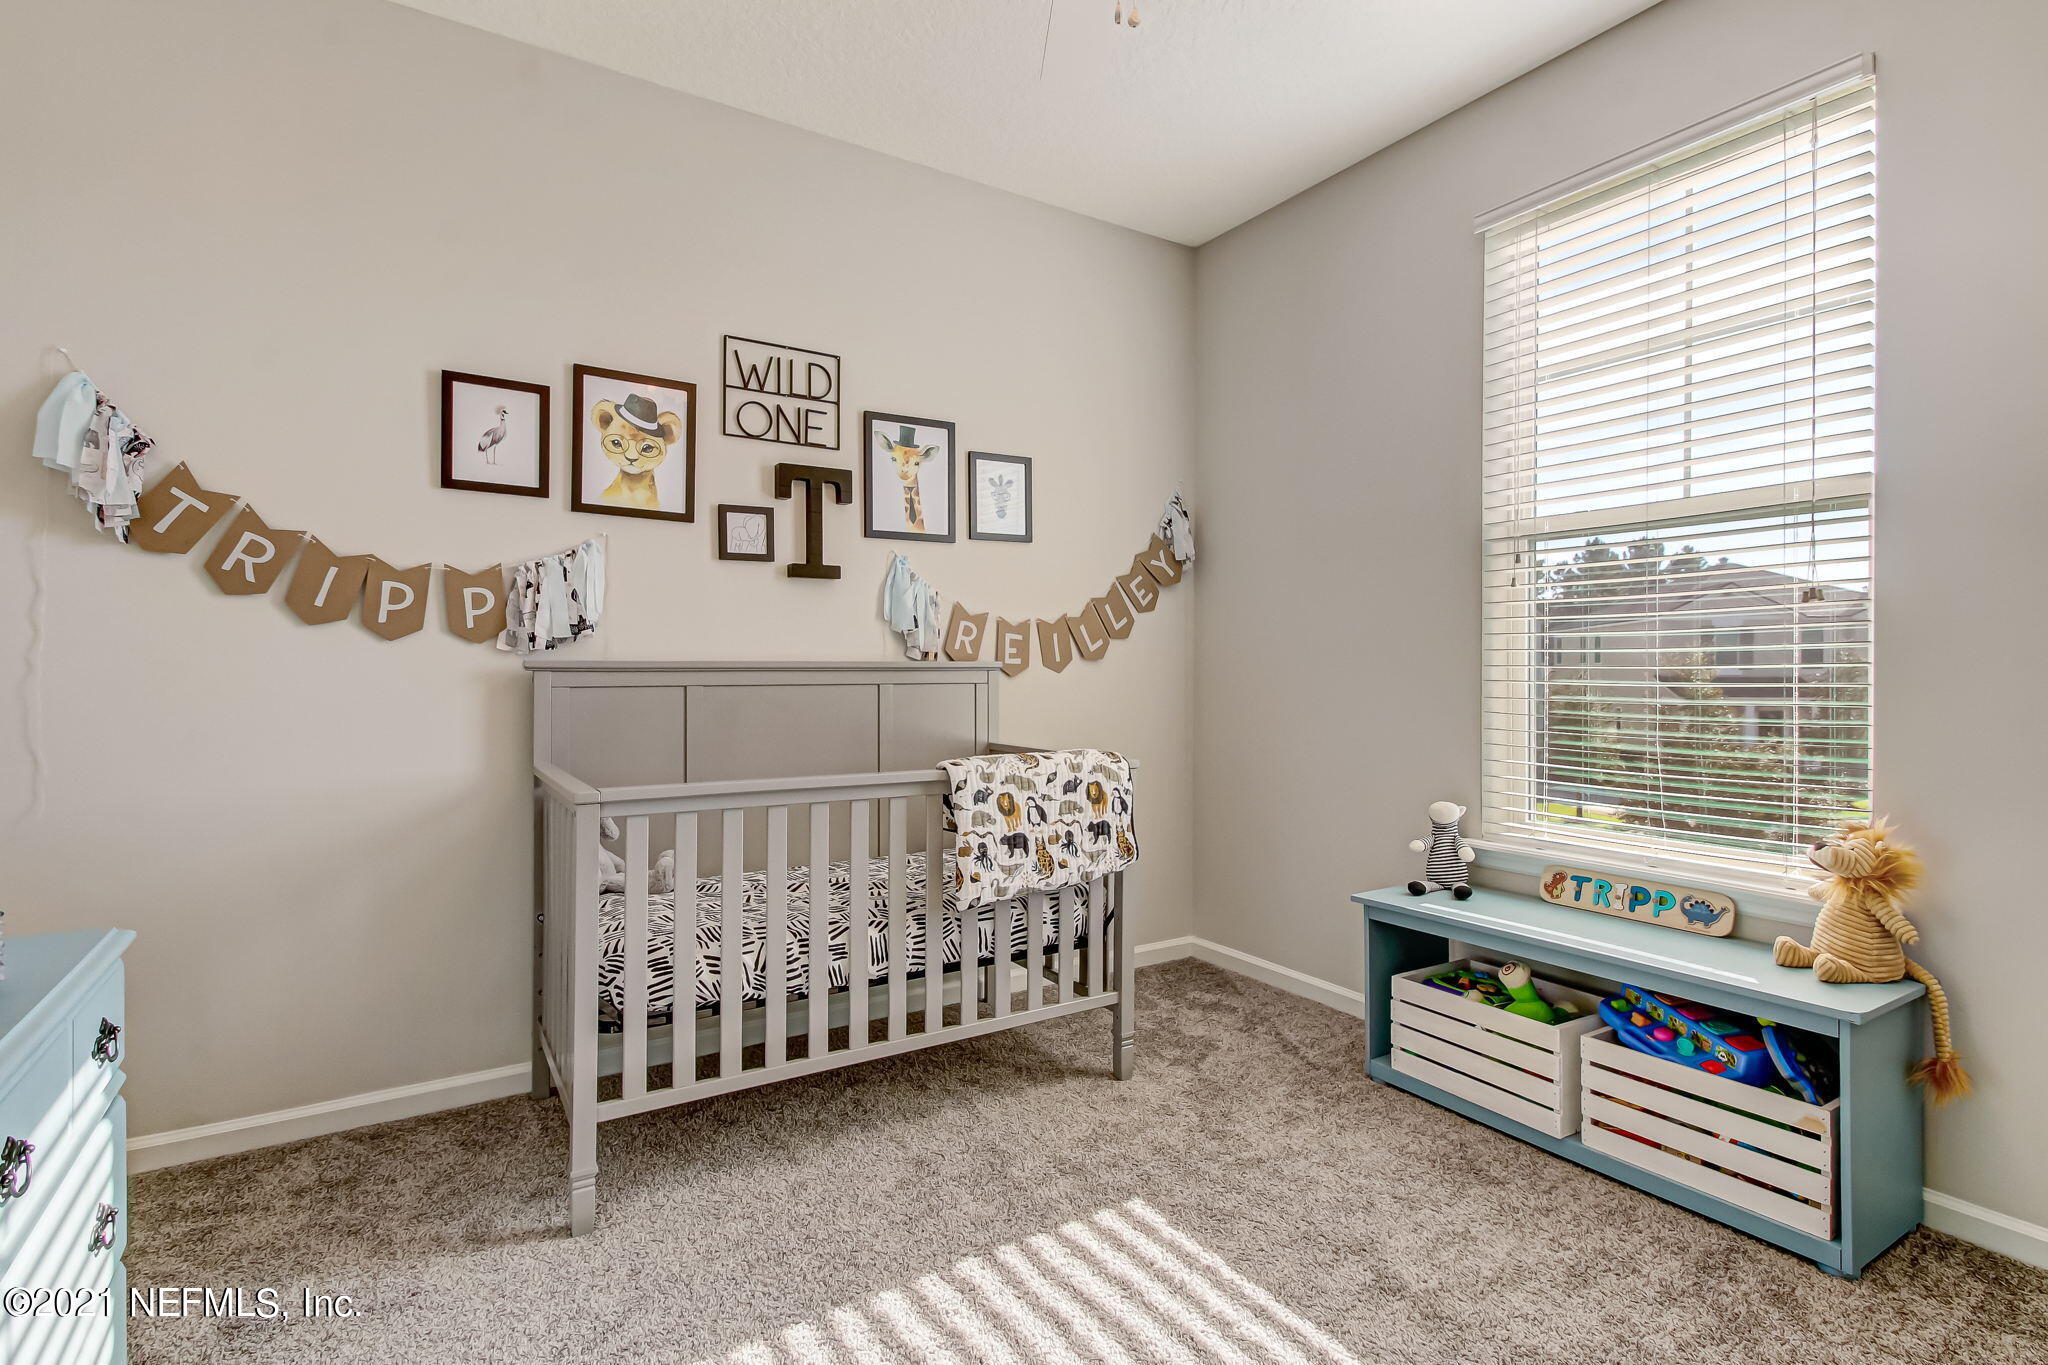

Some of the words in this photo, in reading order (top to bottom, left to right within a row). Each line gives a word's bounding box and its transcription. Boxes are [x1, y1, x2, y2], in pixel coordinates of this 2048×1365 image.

[735, 349, 832, 400] WILD
[736, 401, 828, 446] ONE
[152, 486, 496, 629] TRIPP
[775, 463, 853, 579] T
[954, 549, 1176, 665] REILLEY
[1570, 875, 1676, 918] TRIPP
